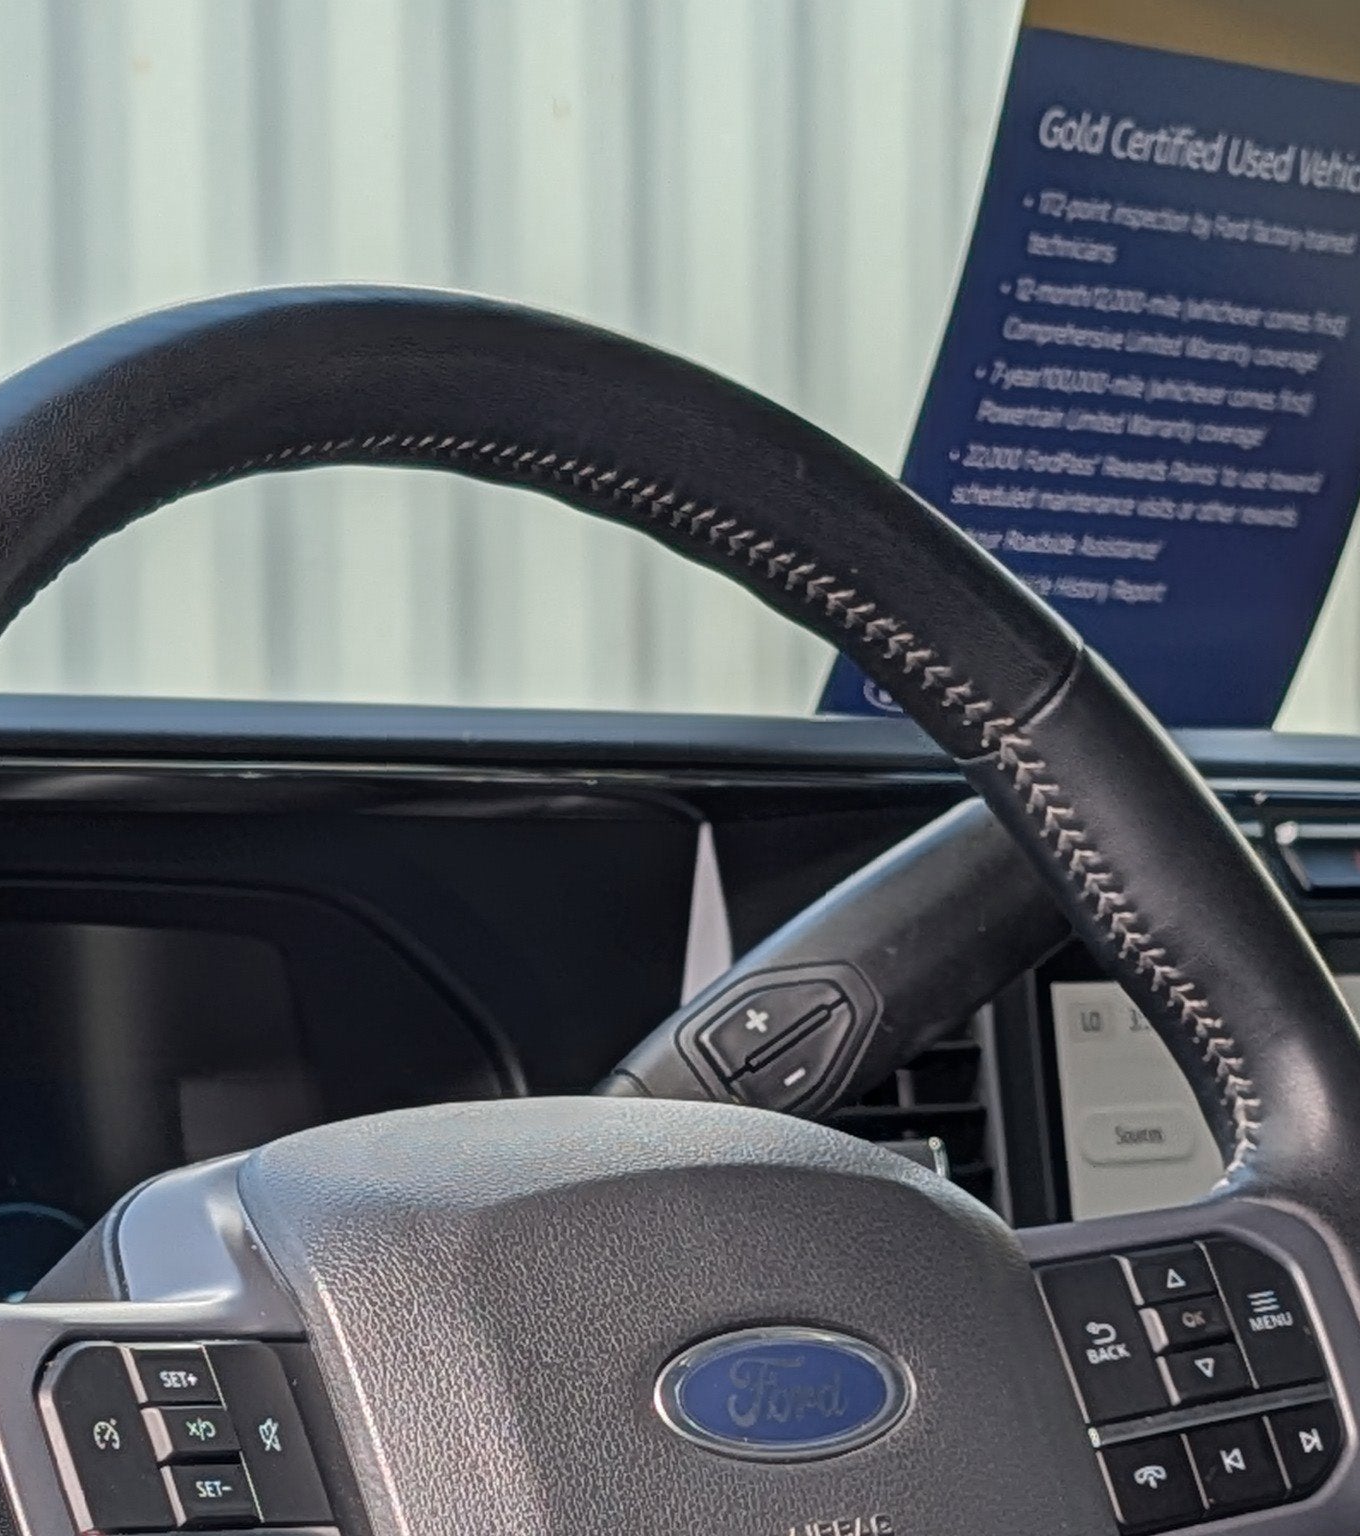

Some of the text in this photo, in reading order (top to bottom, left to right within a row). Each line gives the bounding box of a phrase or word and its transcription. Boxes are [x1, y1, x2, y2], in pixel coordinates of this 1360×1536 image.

[1039, 105, 1110, 154] Gold
[1110, 118, 1227, 173] Certified
[1227, 135, 1297, 183] Used
[1182, 1310, 1206, 1329] OK
[1248, 1311, 1294, 1332] MENU
[1086, 1342, 1131, 1364] BACK
[159, 1370, 198, 1389] SET+
[727, 1354, 846, 1427] Ford
[196, 1480, 233, 1498] SET-
